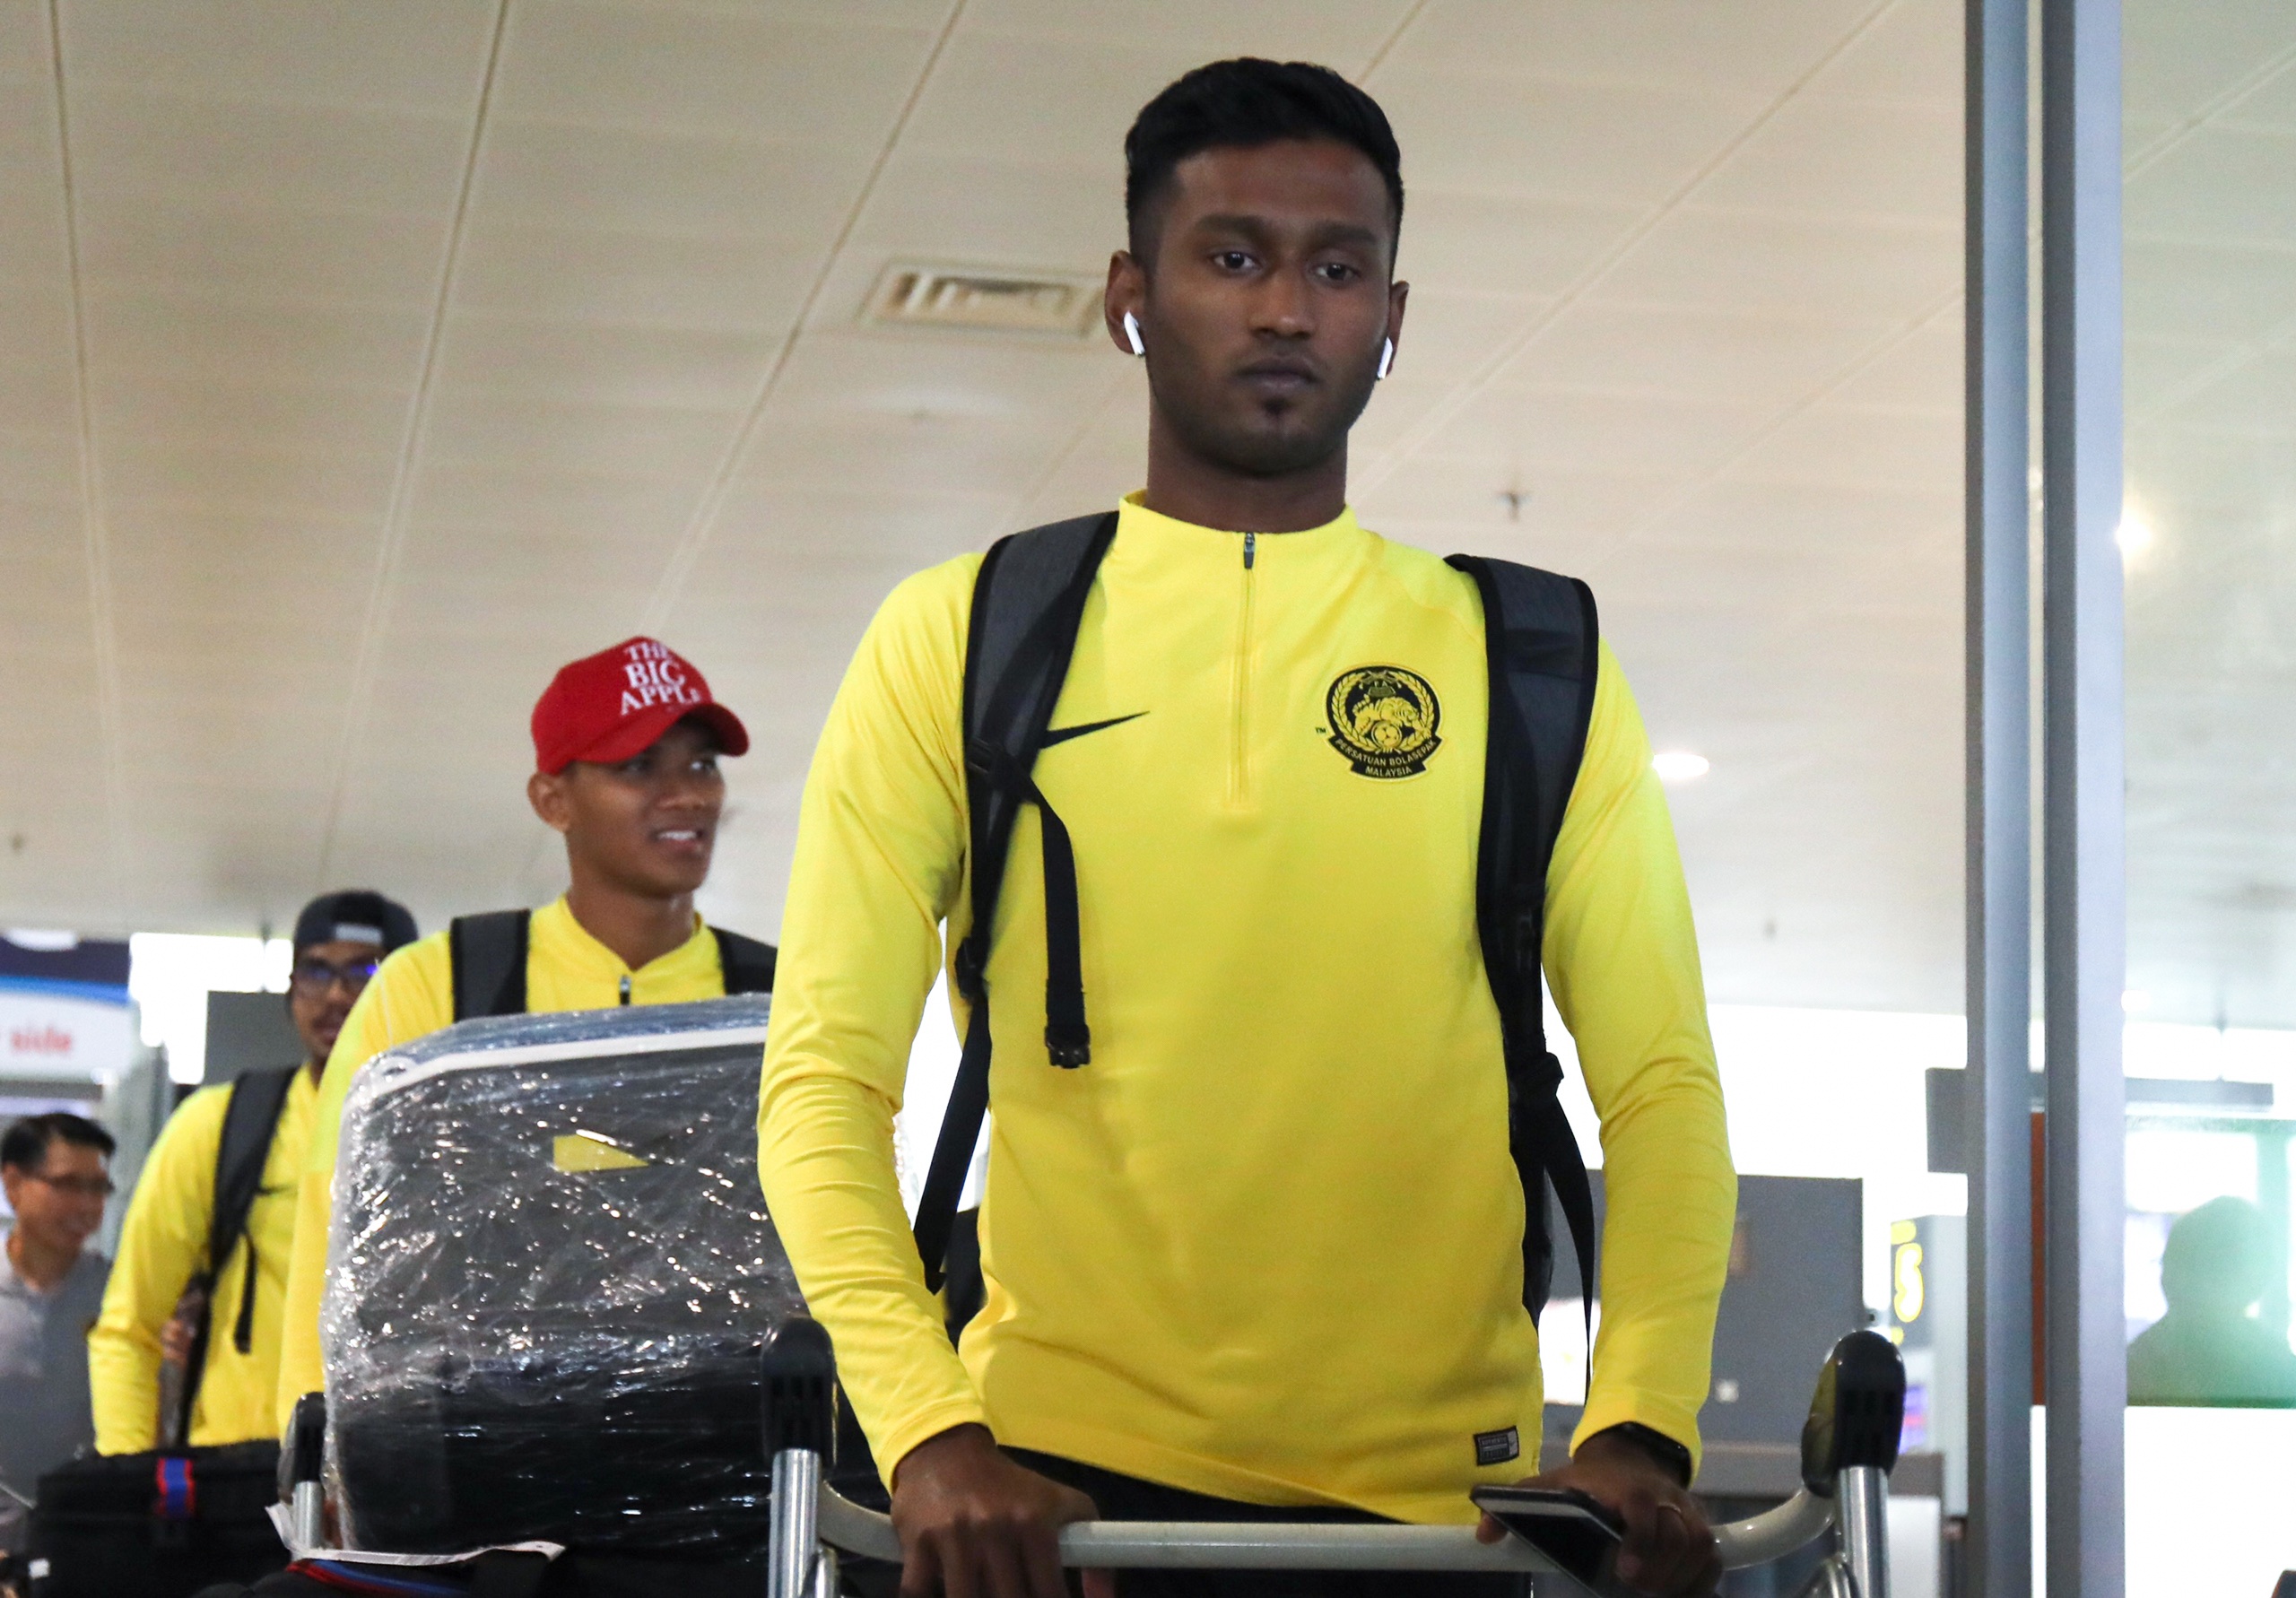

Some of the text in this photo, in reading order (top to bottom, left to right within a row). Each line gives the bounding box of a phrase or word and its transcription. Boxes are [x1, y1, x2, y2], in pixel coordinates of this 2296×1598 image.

[1335, 738, 1436, 767] PERSATUAN BOLASEPAK
[1365, 765, 1413, 777] MALAYSIA
